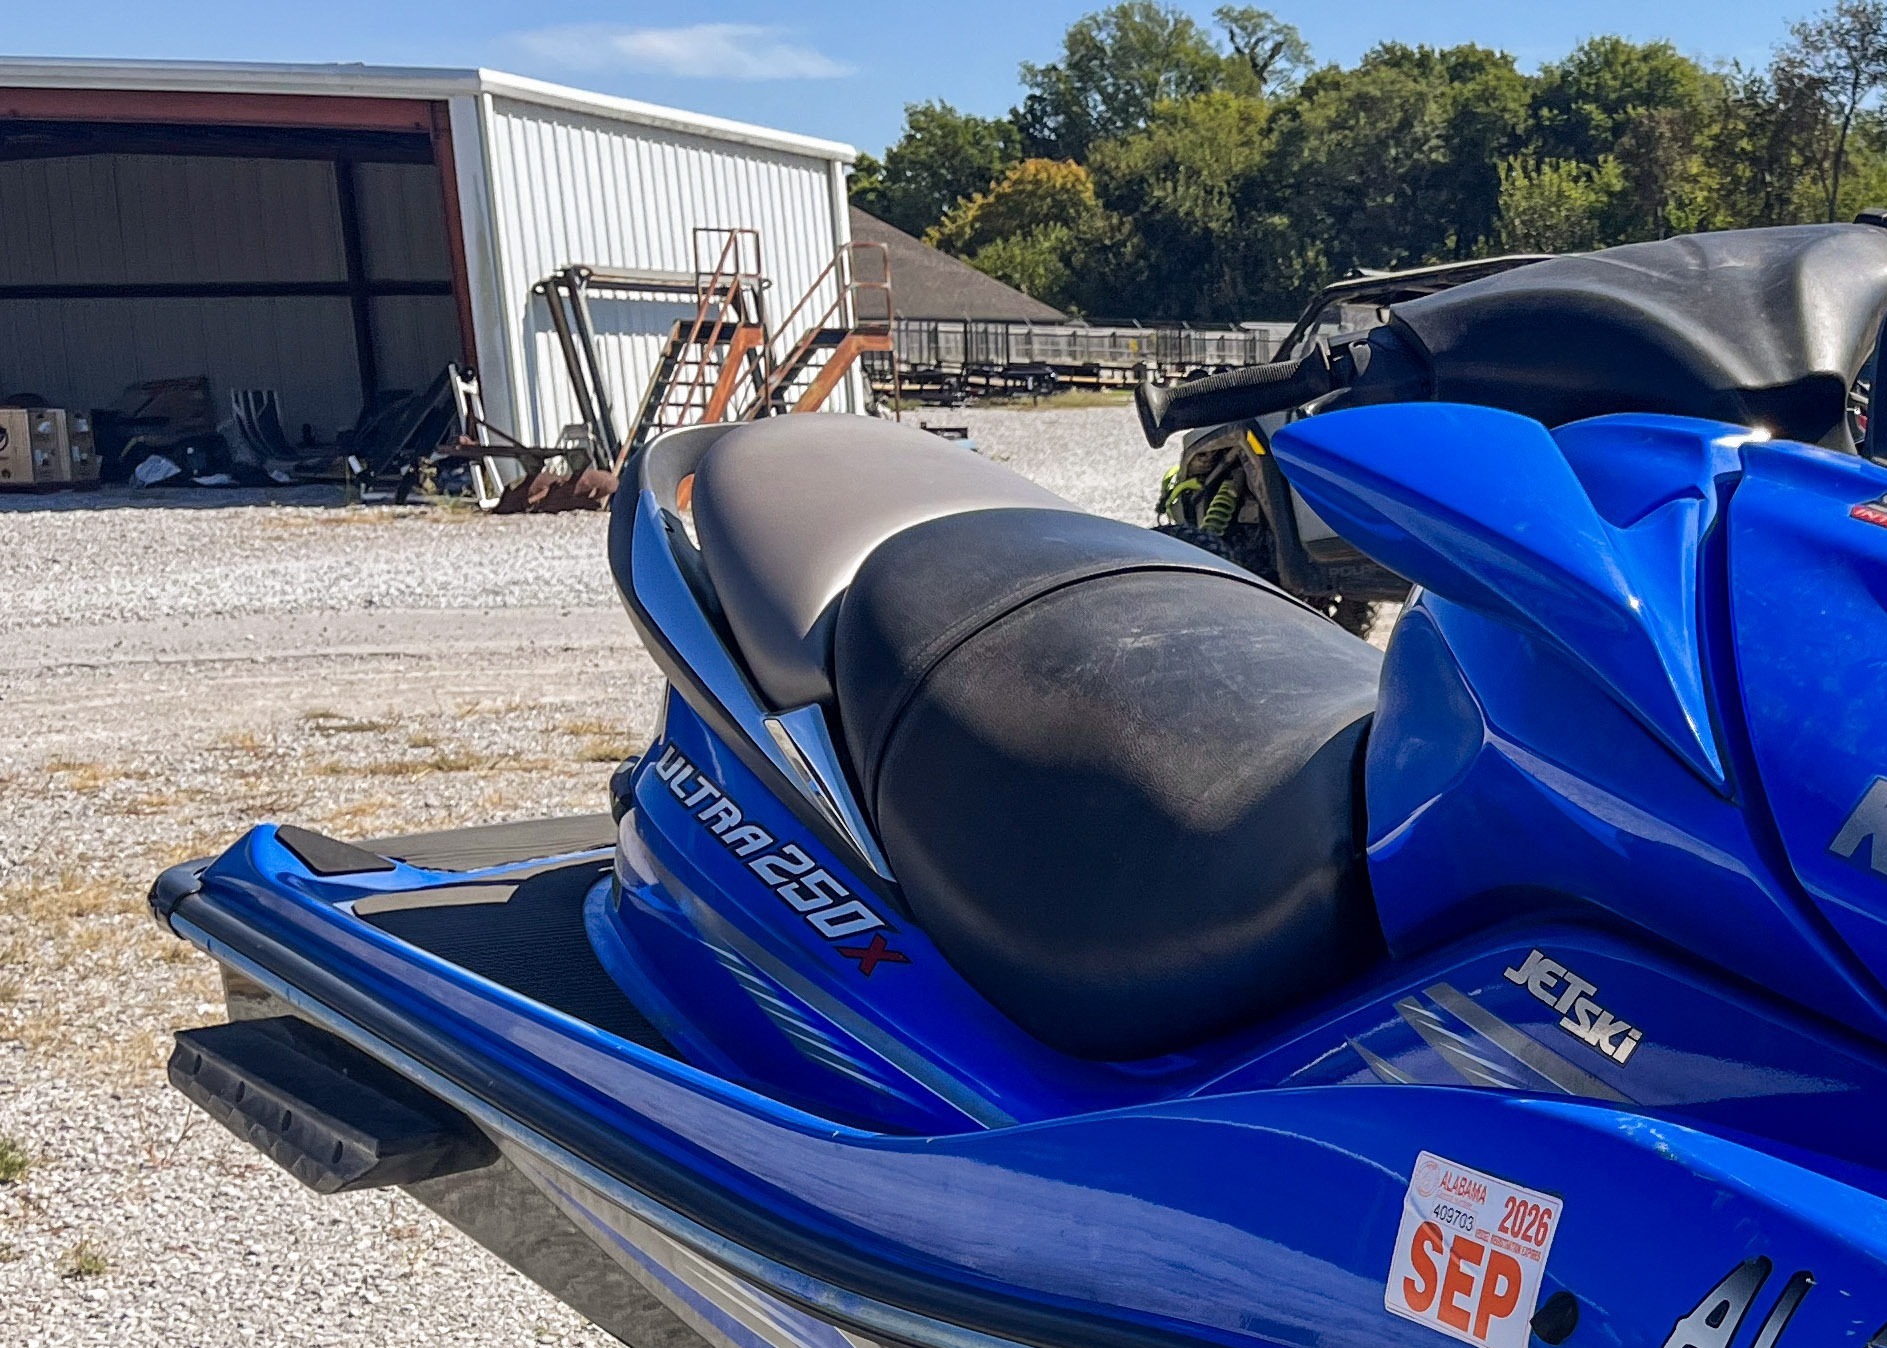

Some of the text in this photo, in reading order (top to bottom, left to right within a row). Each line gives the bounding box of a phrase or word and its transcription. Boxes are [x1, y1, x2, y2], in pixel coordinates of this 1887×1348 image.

[1440, 1170, 1488, 1205] ALABAMA
[1433, 1203, 1476, 1232] 409703
[1497, 1195, 1553, 1247] 2026
[1403, 1220, 1523, 1342] SEP
